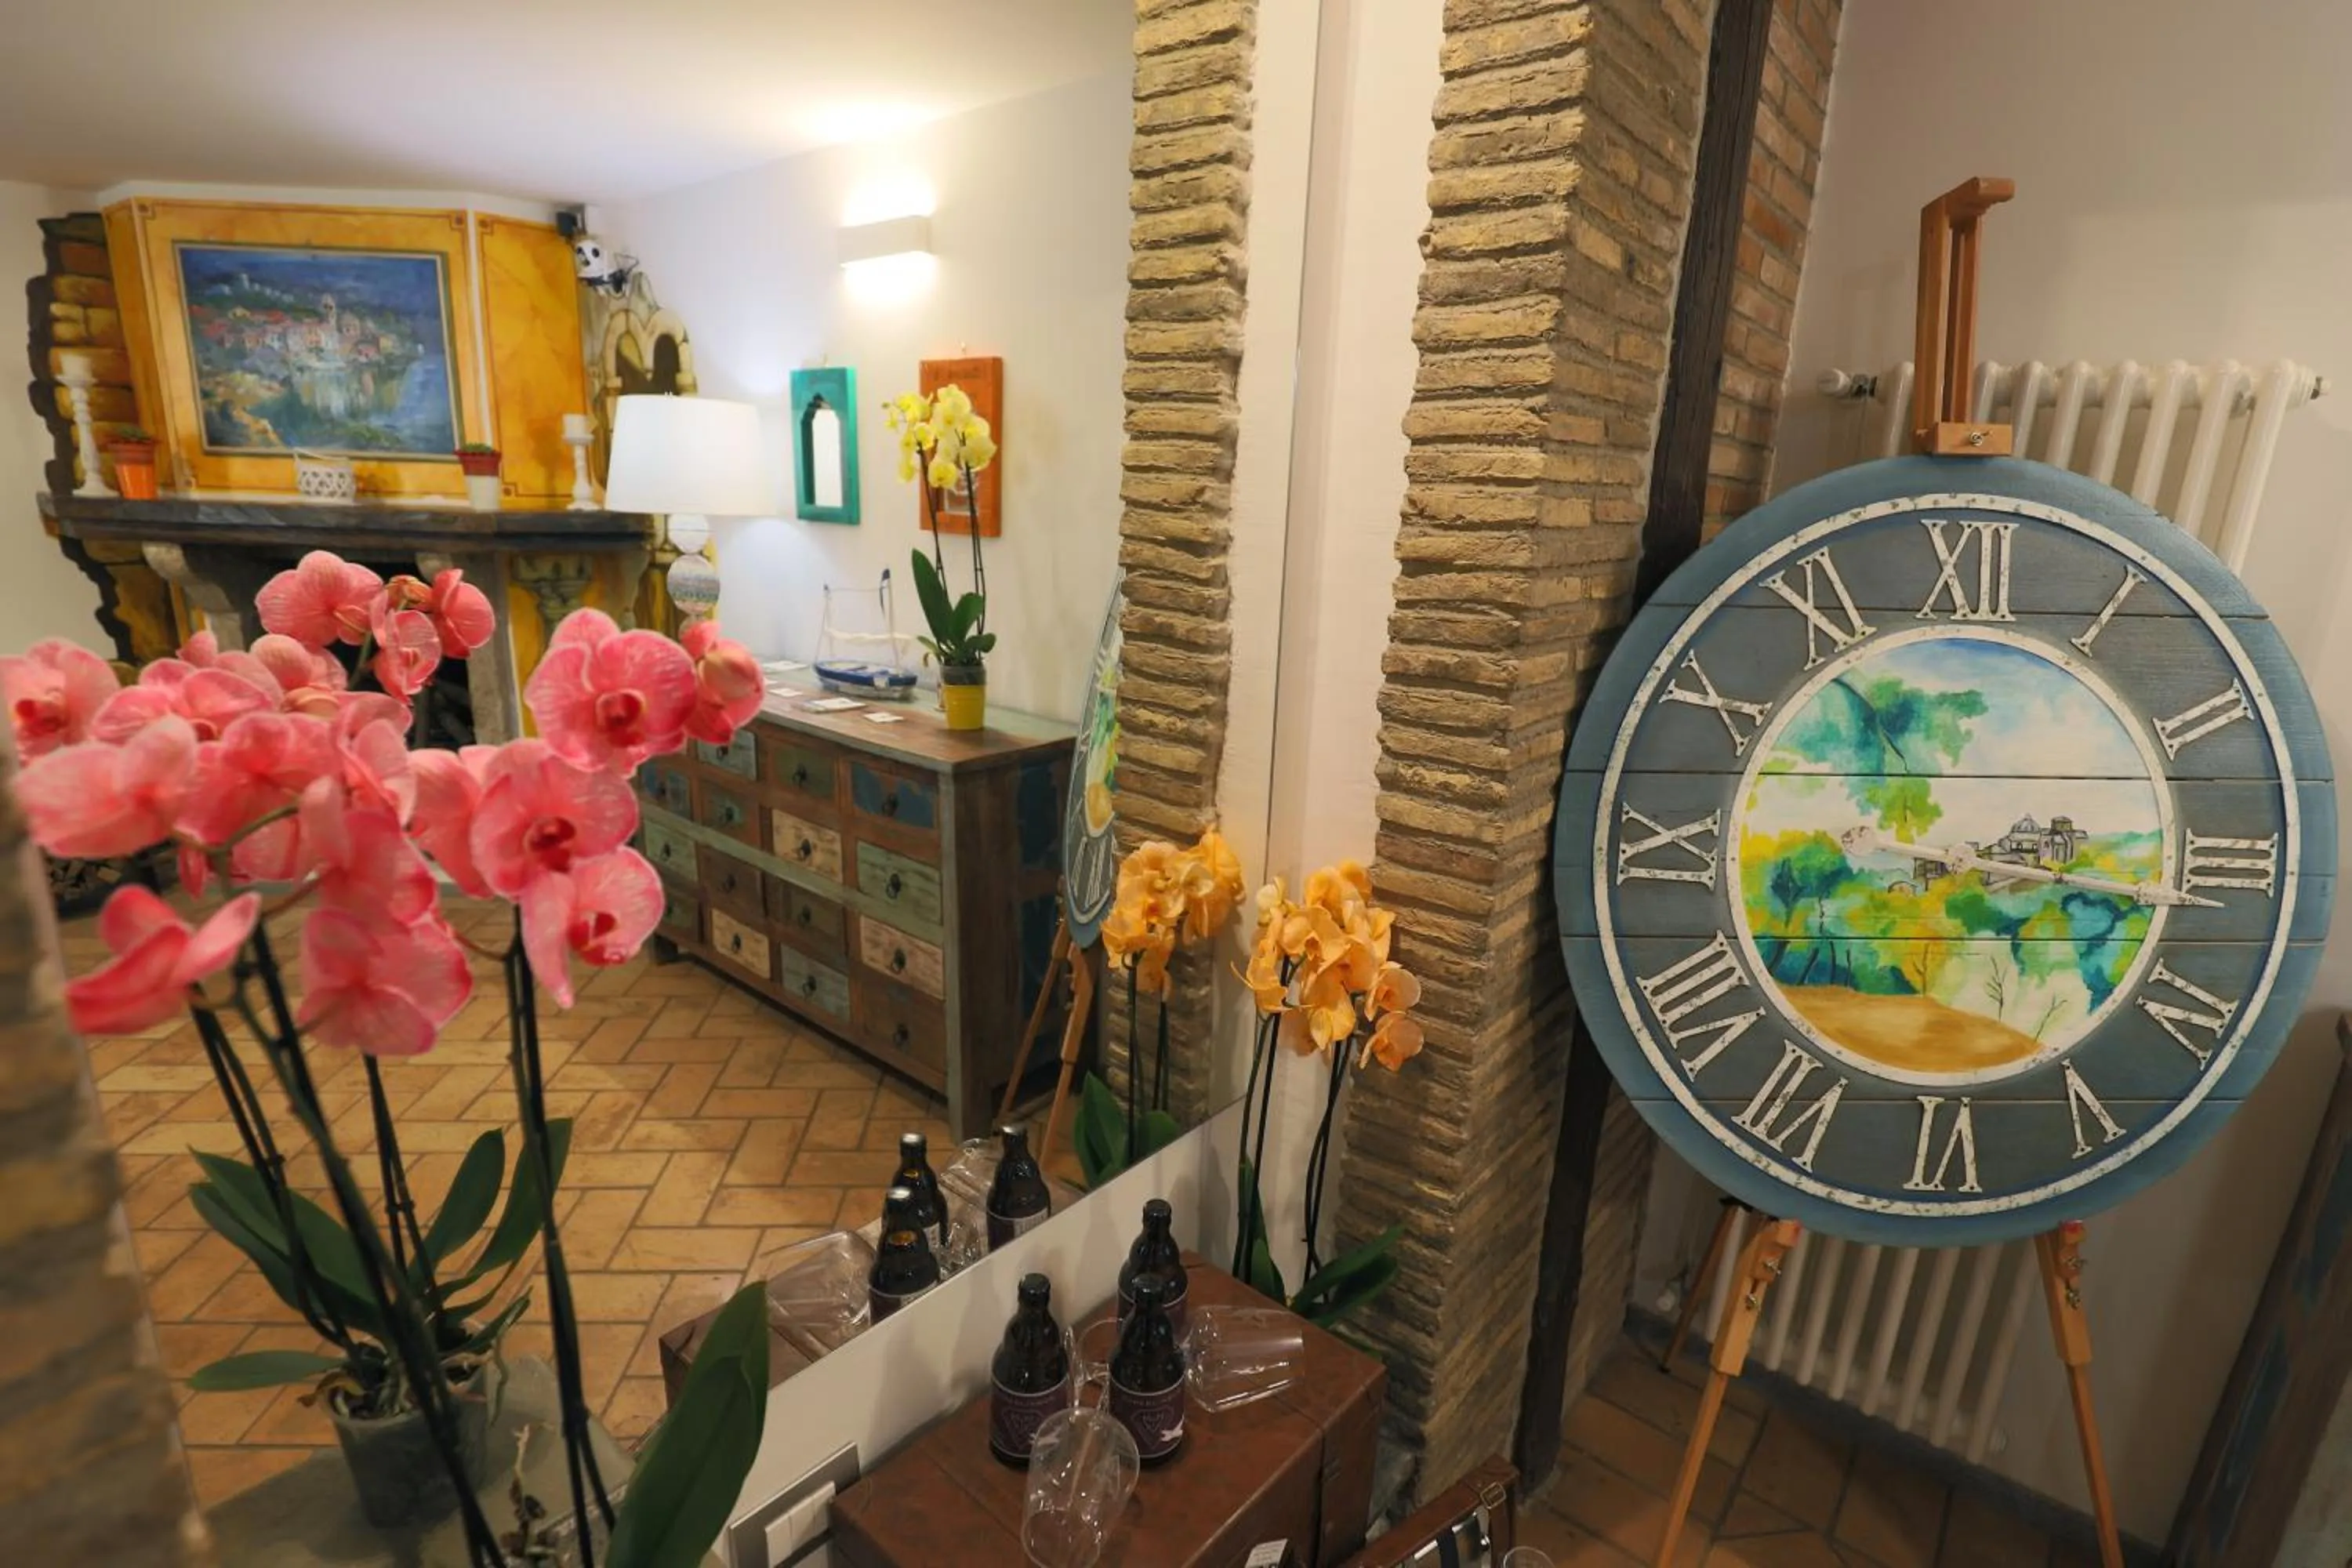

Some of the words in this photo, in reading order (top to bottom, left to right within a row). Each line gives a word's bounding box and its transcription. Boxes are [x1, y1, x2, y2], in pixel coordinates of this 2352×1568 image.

[1759, 546, 1877, 670] XI
[1916, 520, 2020, 622] XII
[2071, 564, 2148, 656] I
[1659, 649, 1773, 757] X
[2154, 678, 2254, 760] II
[1617, 802, 1720, 891] IX
[2182, 828, 2278, 898] III
[1635, 930, 1766, 1082] VIII
[2136, 957, 2239, 1070] IV
[1731, 1039, 1849, 1173] VII
[1903, 1095, 1982, 1192] VI
[2060, 1058, 2127, 1160] V
